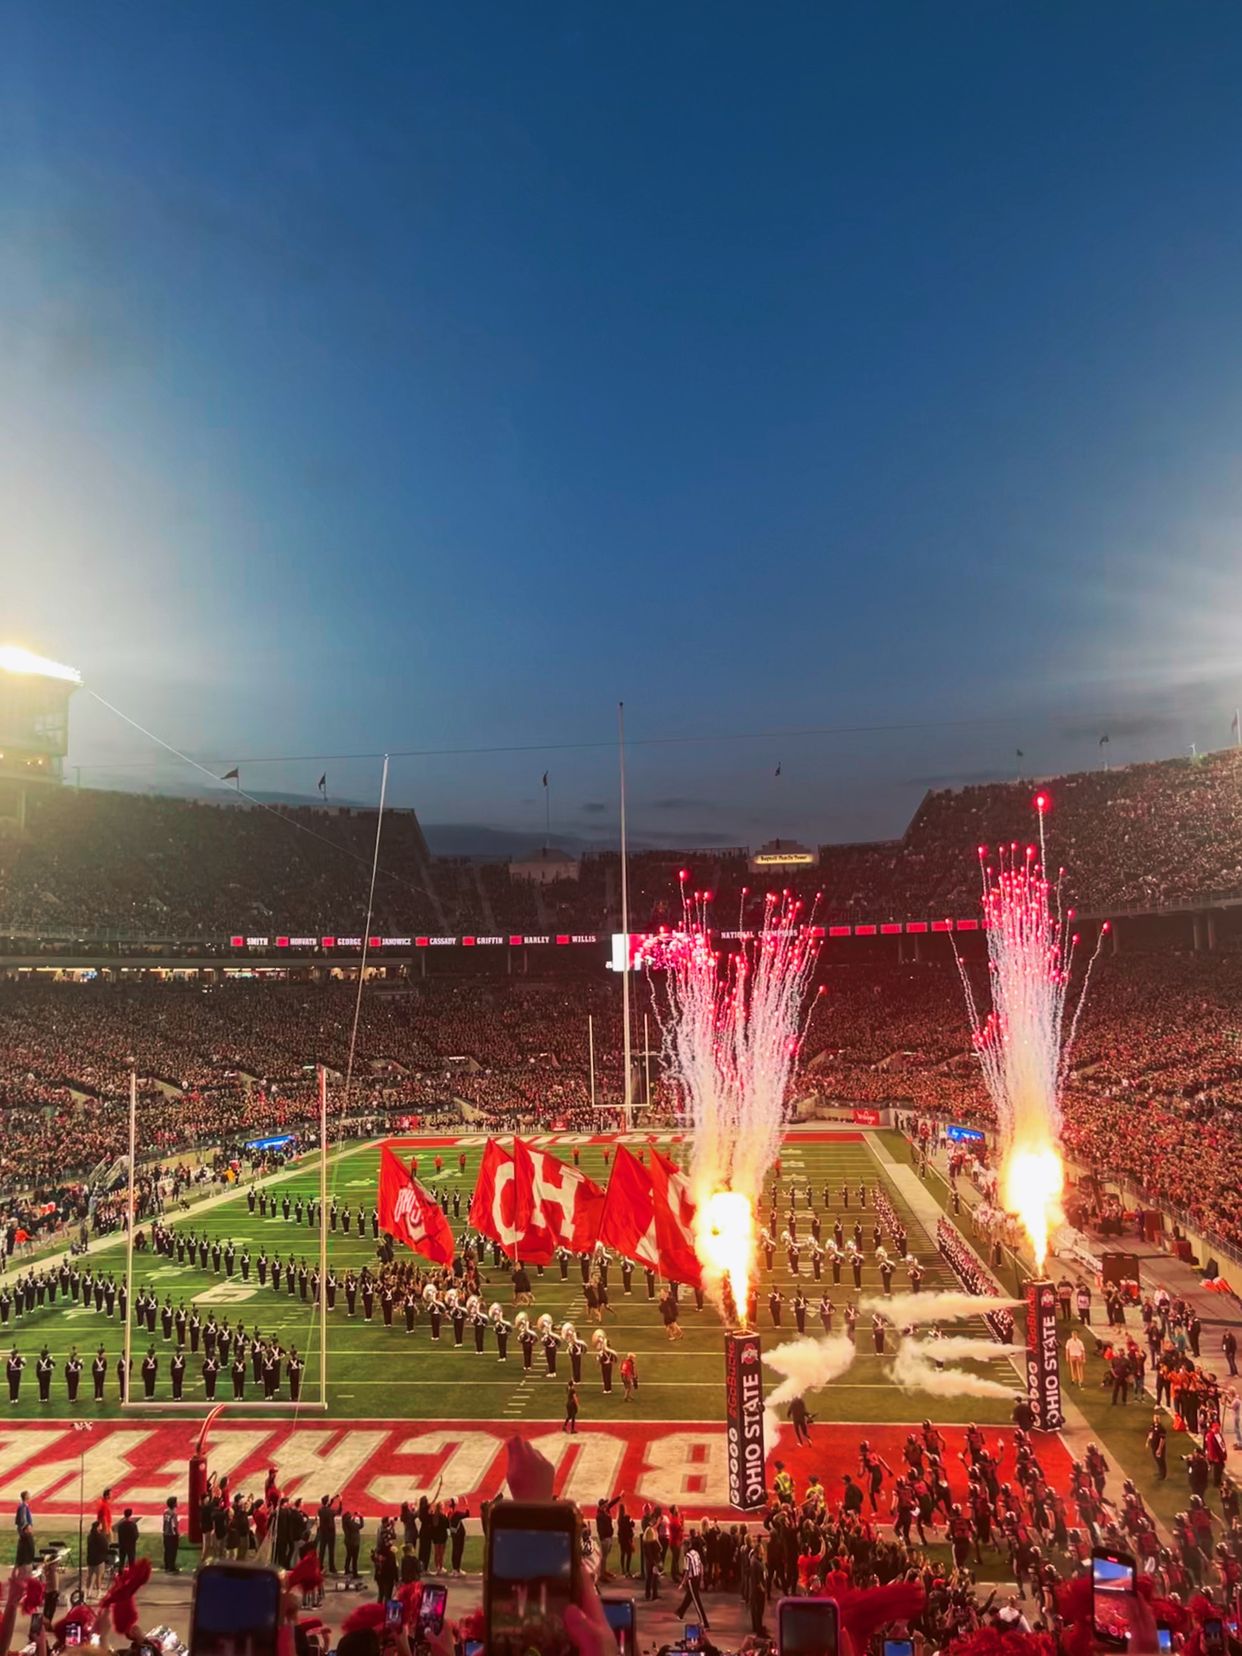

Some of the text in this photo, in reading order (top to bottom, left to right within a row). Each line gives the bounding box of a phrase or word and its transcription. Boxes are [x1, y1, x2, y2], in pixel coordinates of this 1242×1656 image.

[246, 938, 269, 946] SMITH
[337, 938, 362, 946] GEORGE
[477, 937, 503, 945] GRIFFIN
[572, 935, 596, 943] WILLIS
[1042, 1315, 1057, 1370] STATE
[743, 1373, 761, 1439] STATE
[1045, 1377, 1059, 1426] OHIO
[744, 1444, 762, 1503] OHIO
